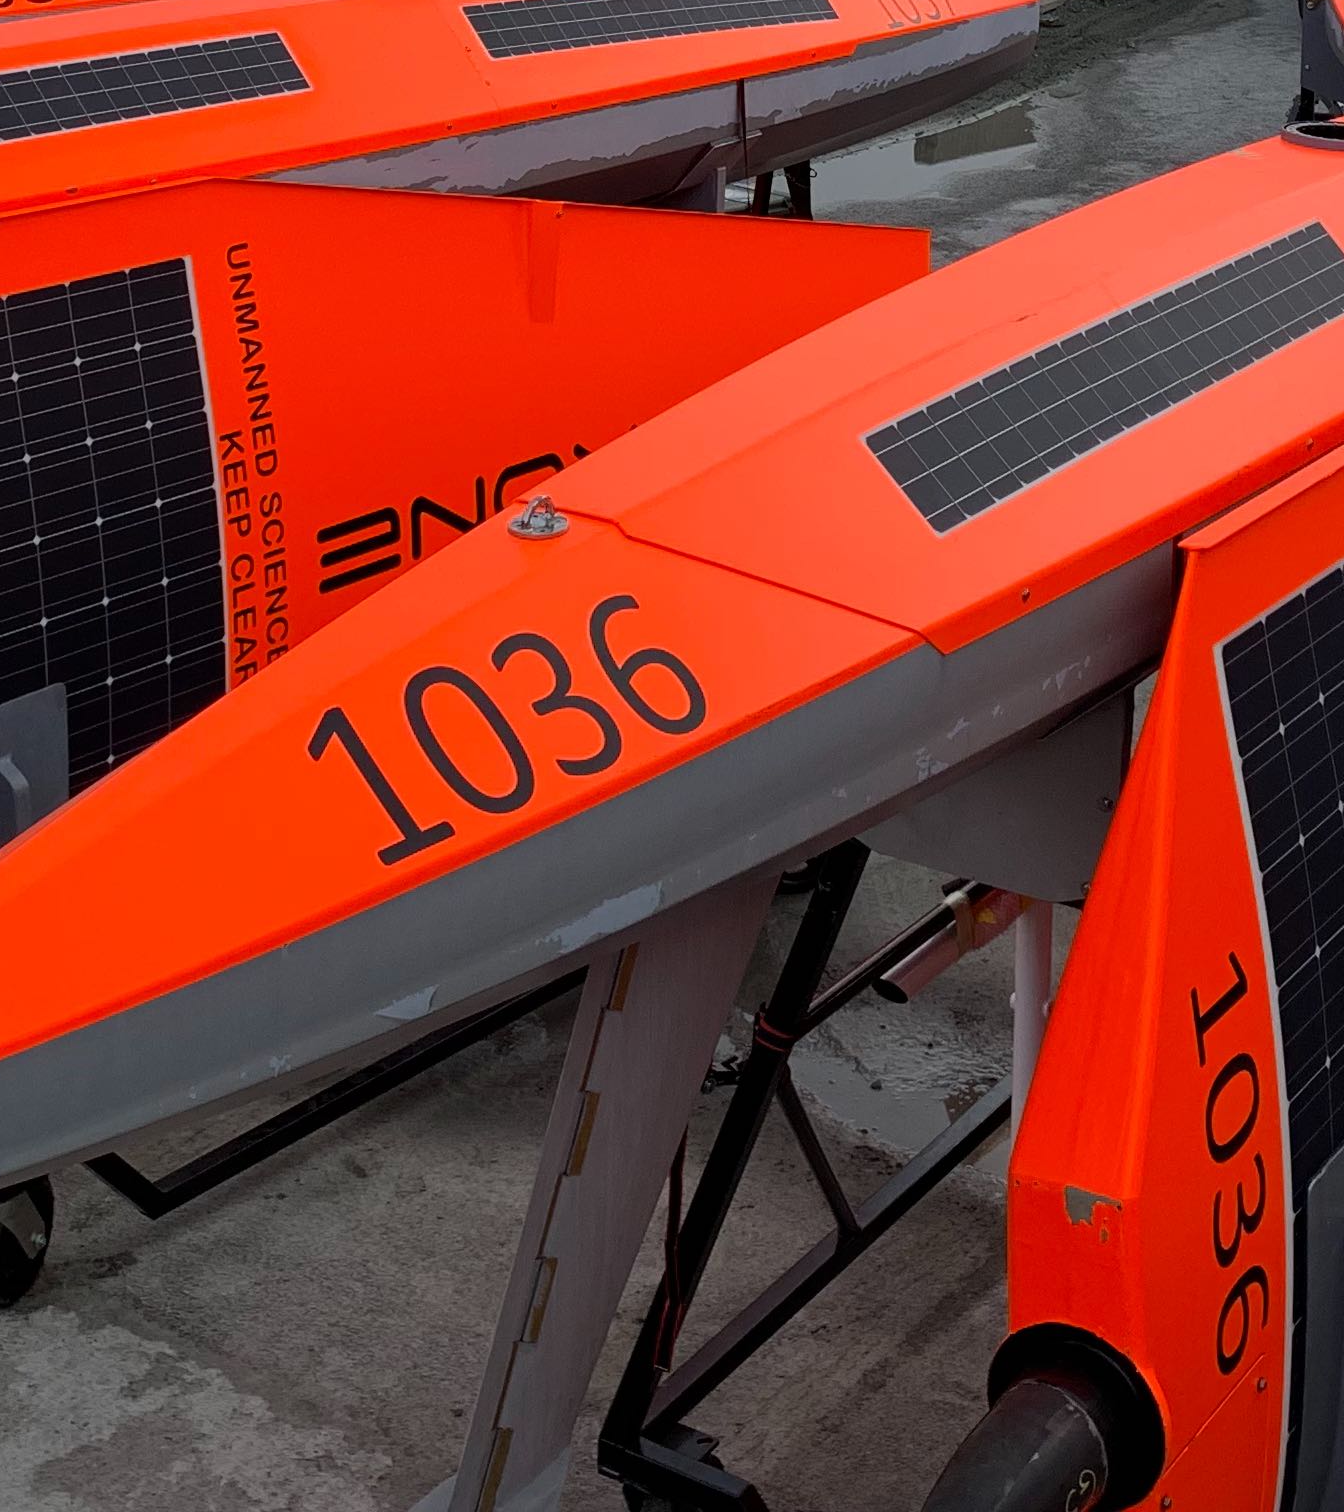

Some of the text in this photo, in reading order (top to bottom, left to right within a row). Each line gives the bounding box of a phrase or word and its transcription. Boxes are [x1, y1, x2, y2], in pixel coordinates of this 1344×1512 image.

[219, 431, 257, 684] KEEP CLEAR
[226, 243, 289, 665] UNMANNED SCIENCE
[307, 594, 707, 866] 1036
[1191, 951, 1270, 1376] 1036
